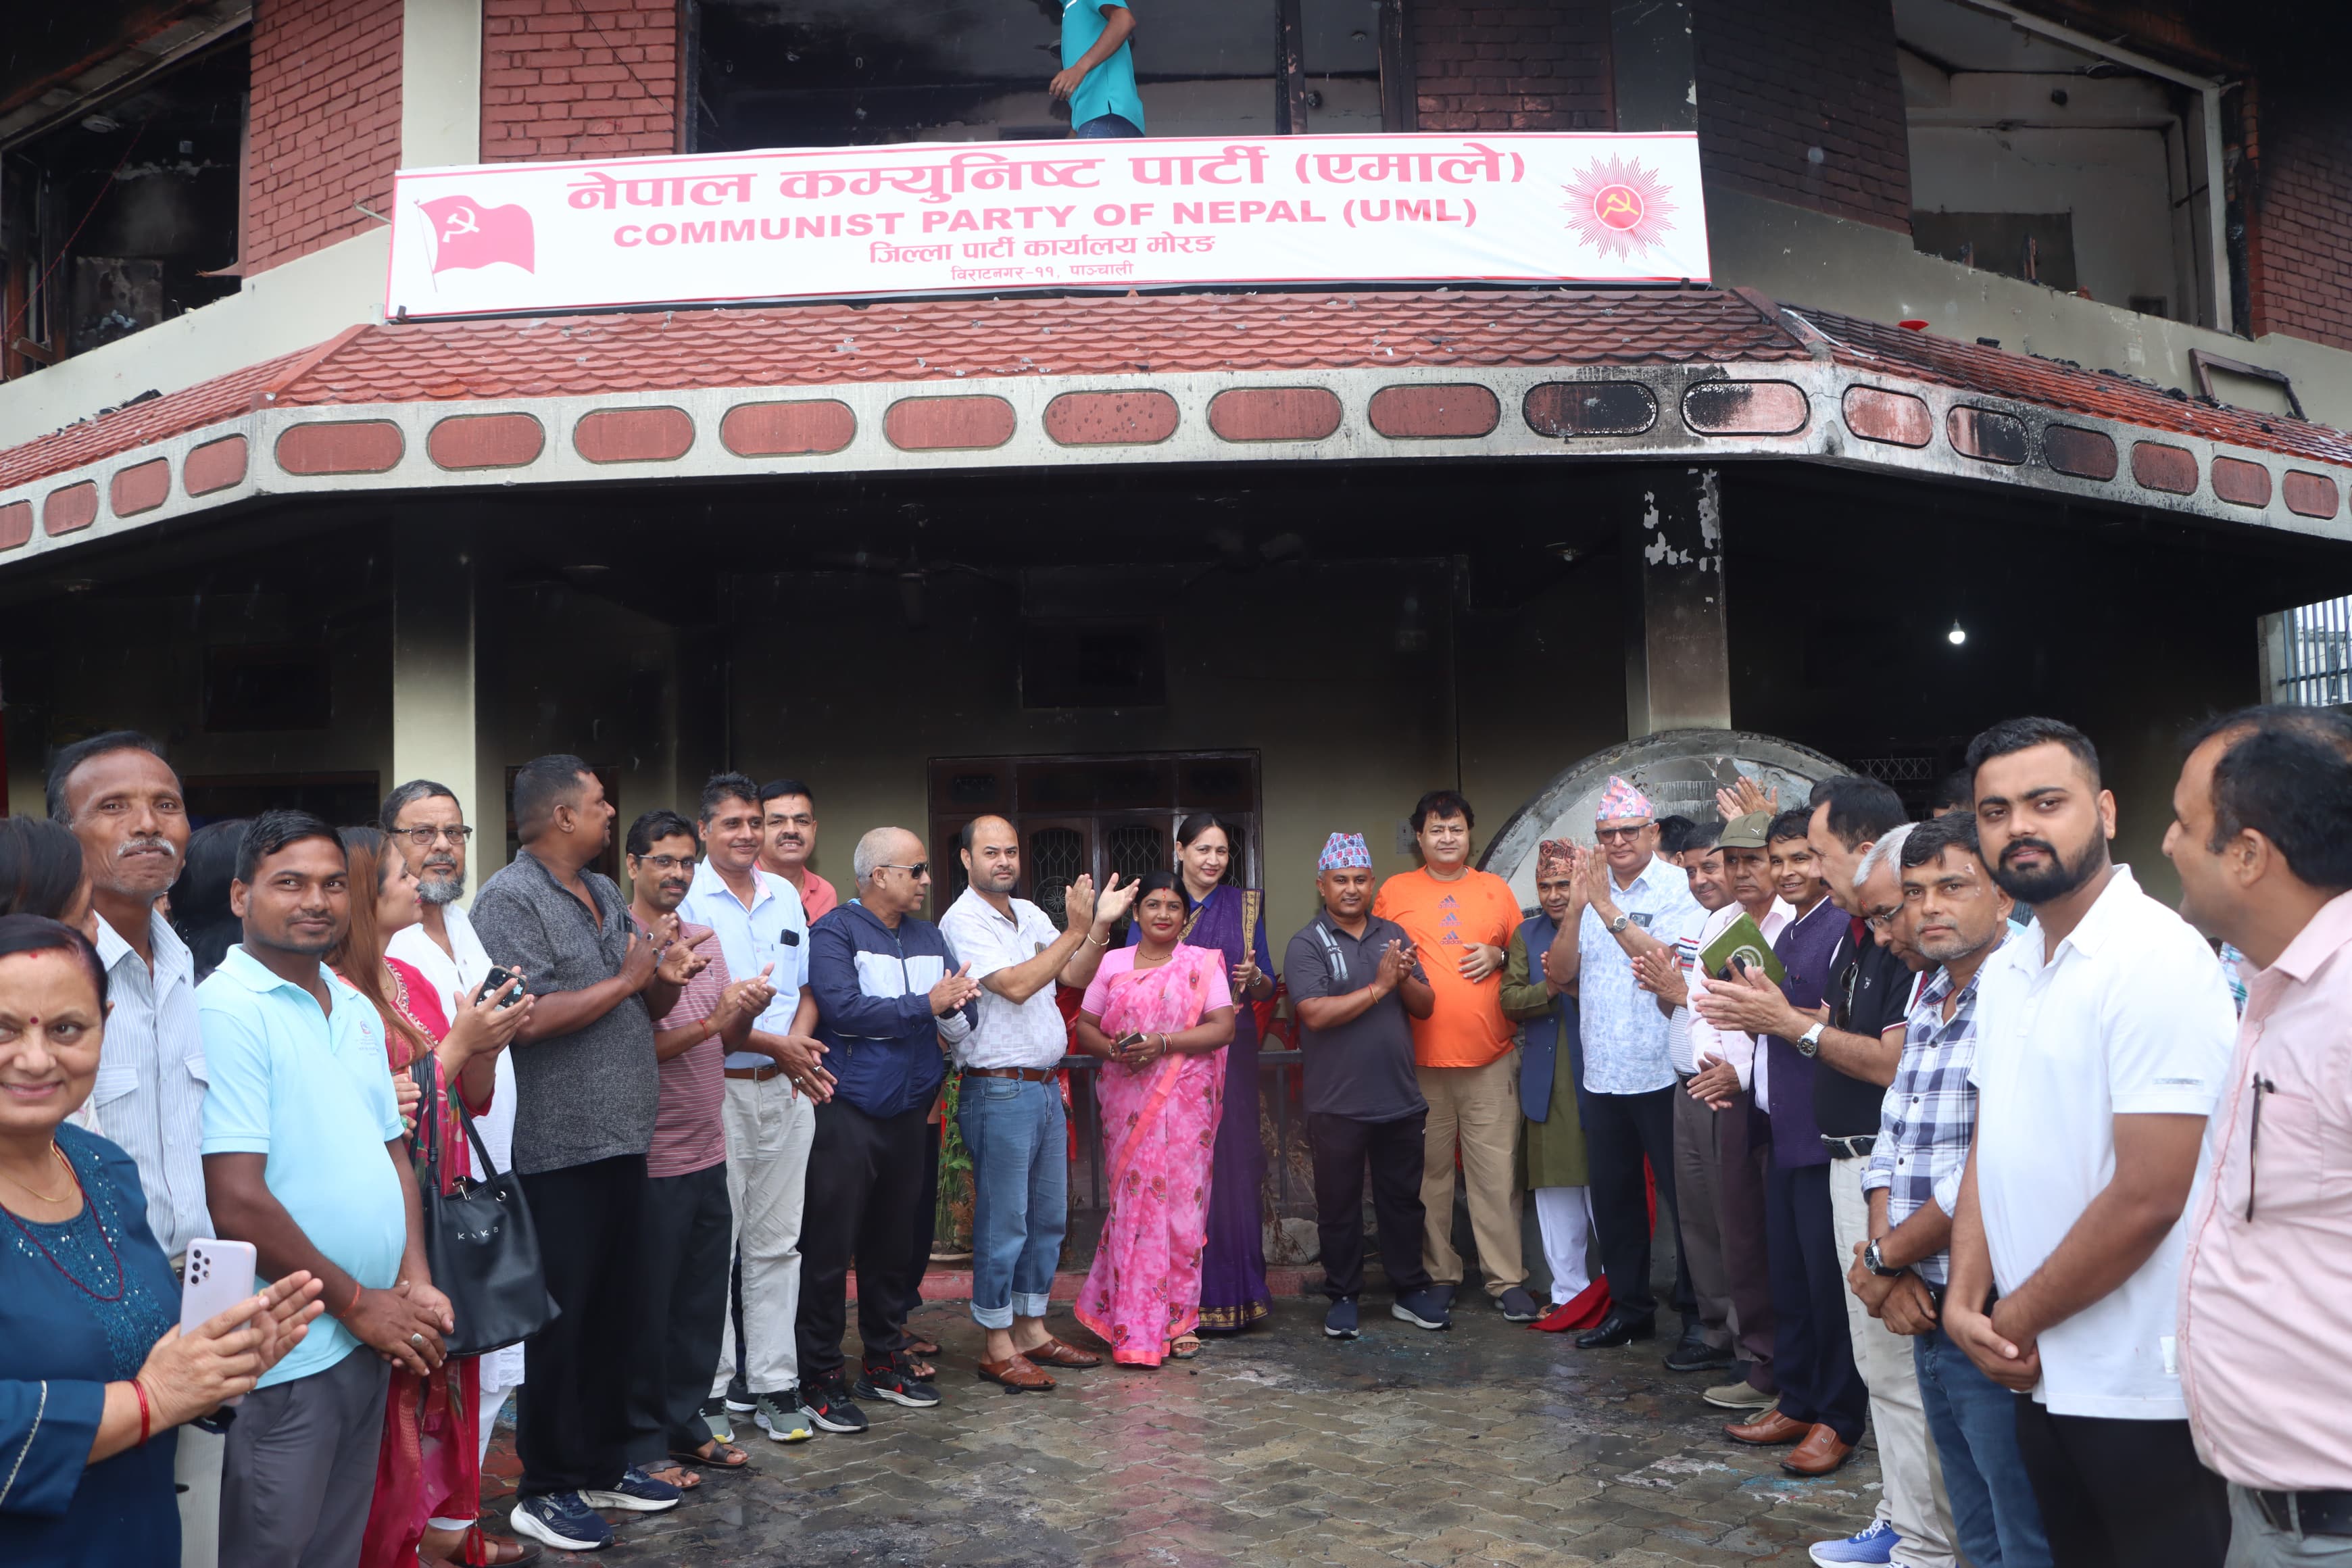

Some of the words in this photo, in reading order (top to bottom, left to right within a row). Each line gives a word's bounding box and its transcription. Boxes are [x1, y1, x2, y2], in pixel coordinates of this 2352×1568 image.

[567, 172, 757, 210] नेपाल
[779, 153, 1106, 203] कम्युनिष्ट
[1128, 145, 1269, 185] पार्टी
[1296, 143, 1525, 184] (एमाले)
[614, 212, 905, 247] COMMUNIST
[923, 205, 1077, 232] PARTY
[1094, 203, 1154, 226] OF
[1173, 200, 1326, 224] NEPAL
[1344, 199, 1476, 228] (UML)
[870, 241, 952, 263] जिल्ला
[962, 237, 1016, 259] पार्टी
[1024, 234, 1138, 256] कार्यालय
